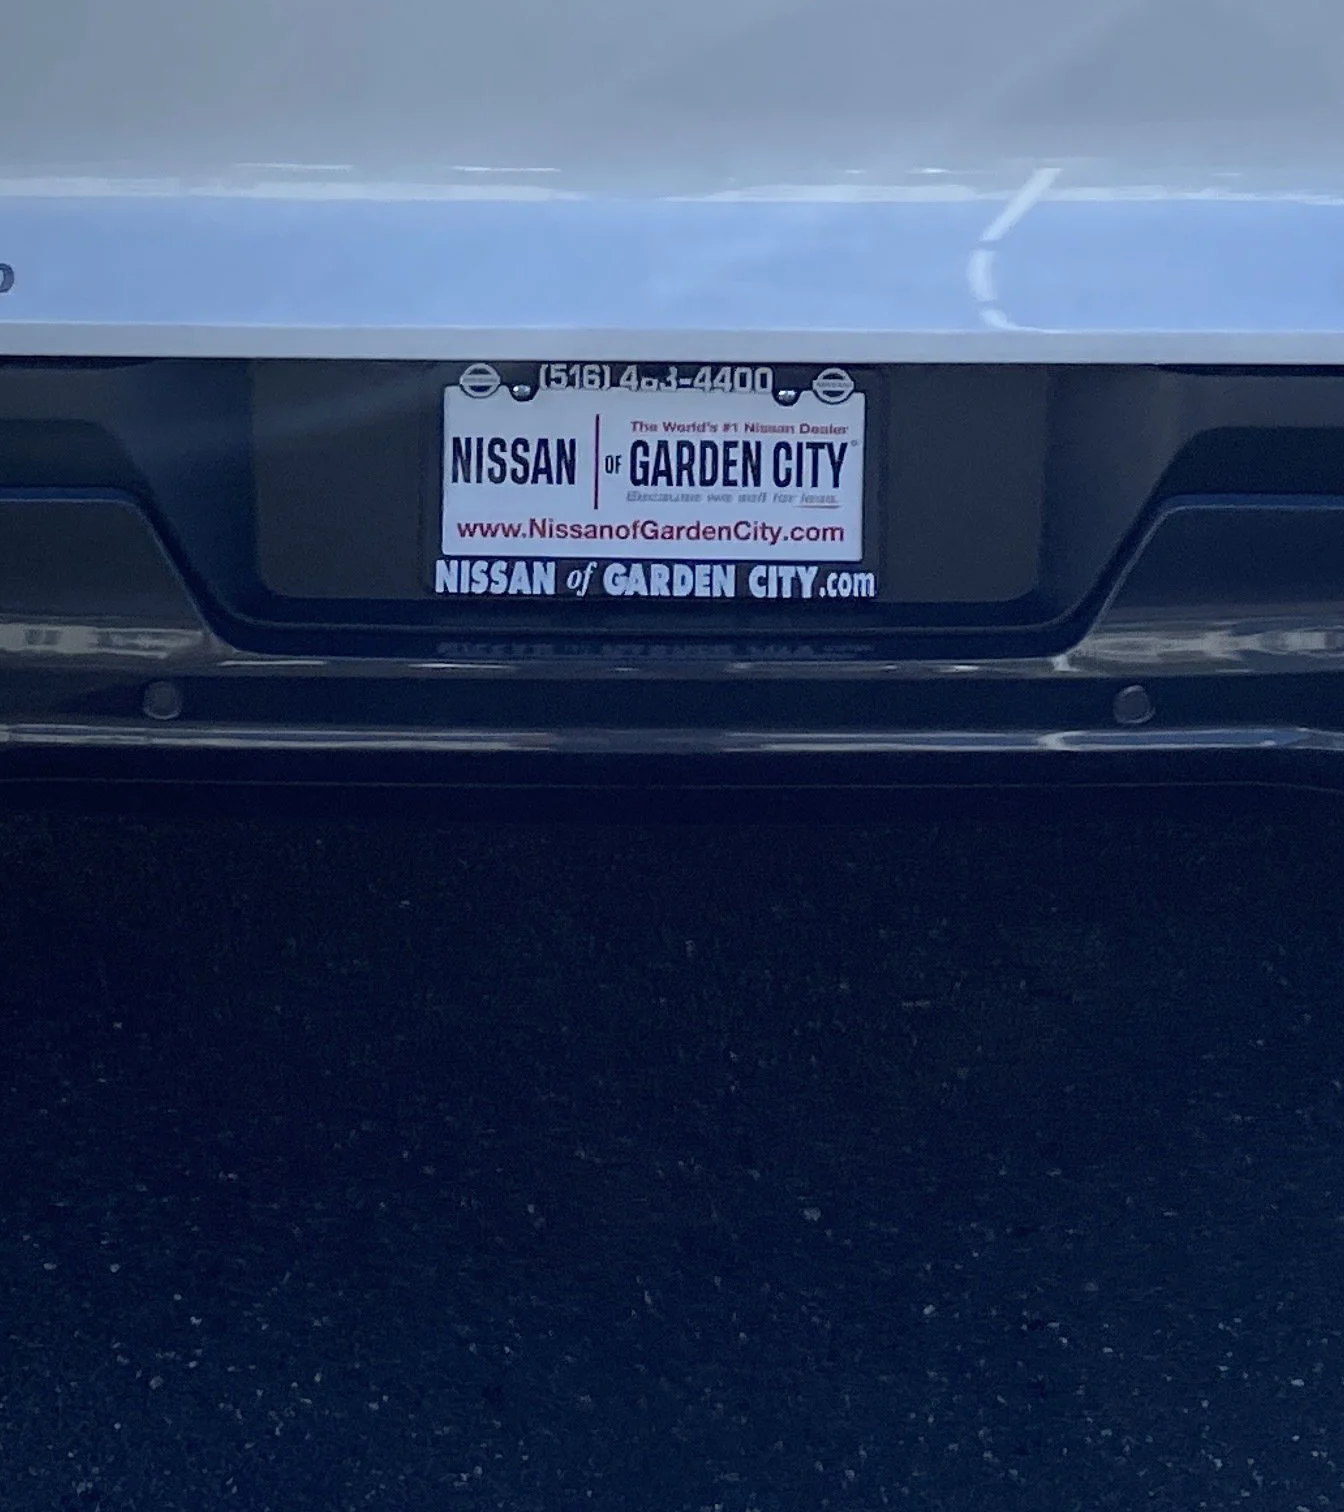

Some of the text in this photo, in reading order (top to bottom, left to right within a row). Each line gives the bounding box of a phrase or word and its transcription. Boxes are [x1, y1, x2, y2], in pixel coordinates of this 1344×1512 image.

[539, 363, 611, 390] (516)
[631, 420, 656, 433] The
[662, 420, 718, 434] World's
[452, 436, 848, 488] NISSAN OF GARDEN CITY
[457, 518, 844, 545] www.NissanofGardenCity.com
[435, 559, 875, 598] NISSAN of GARDEN CITY.com
